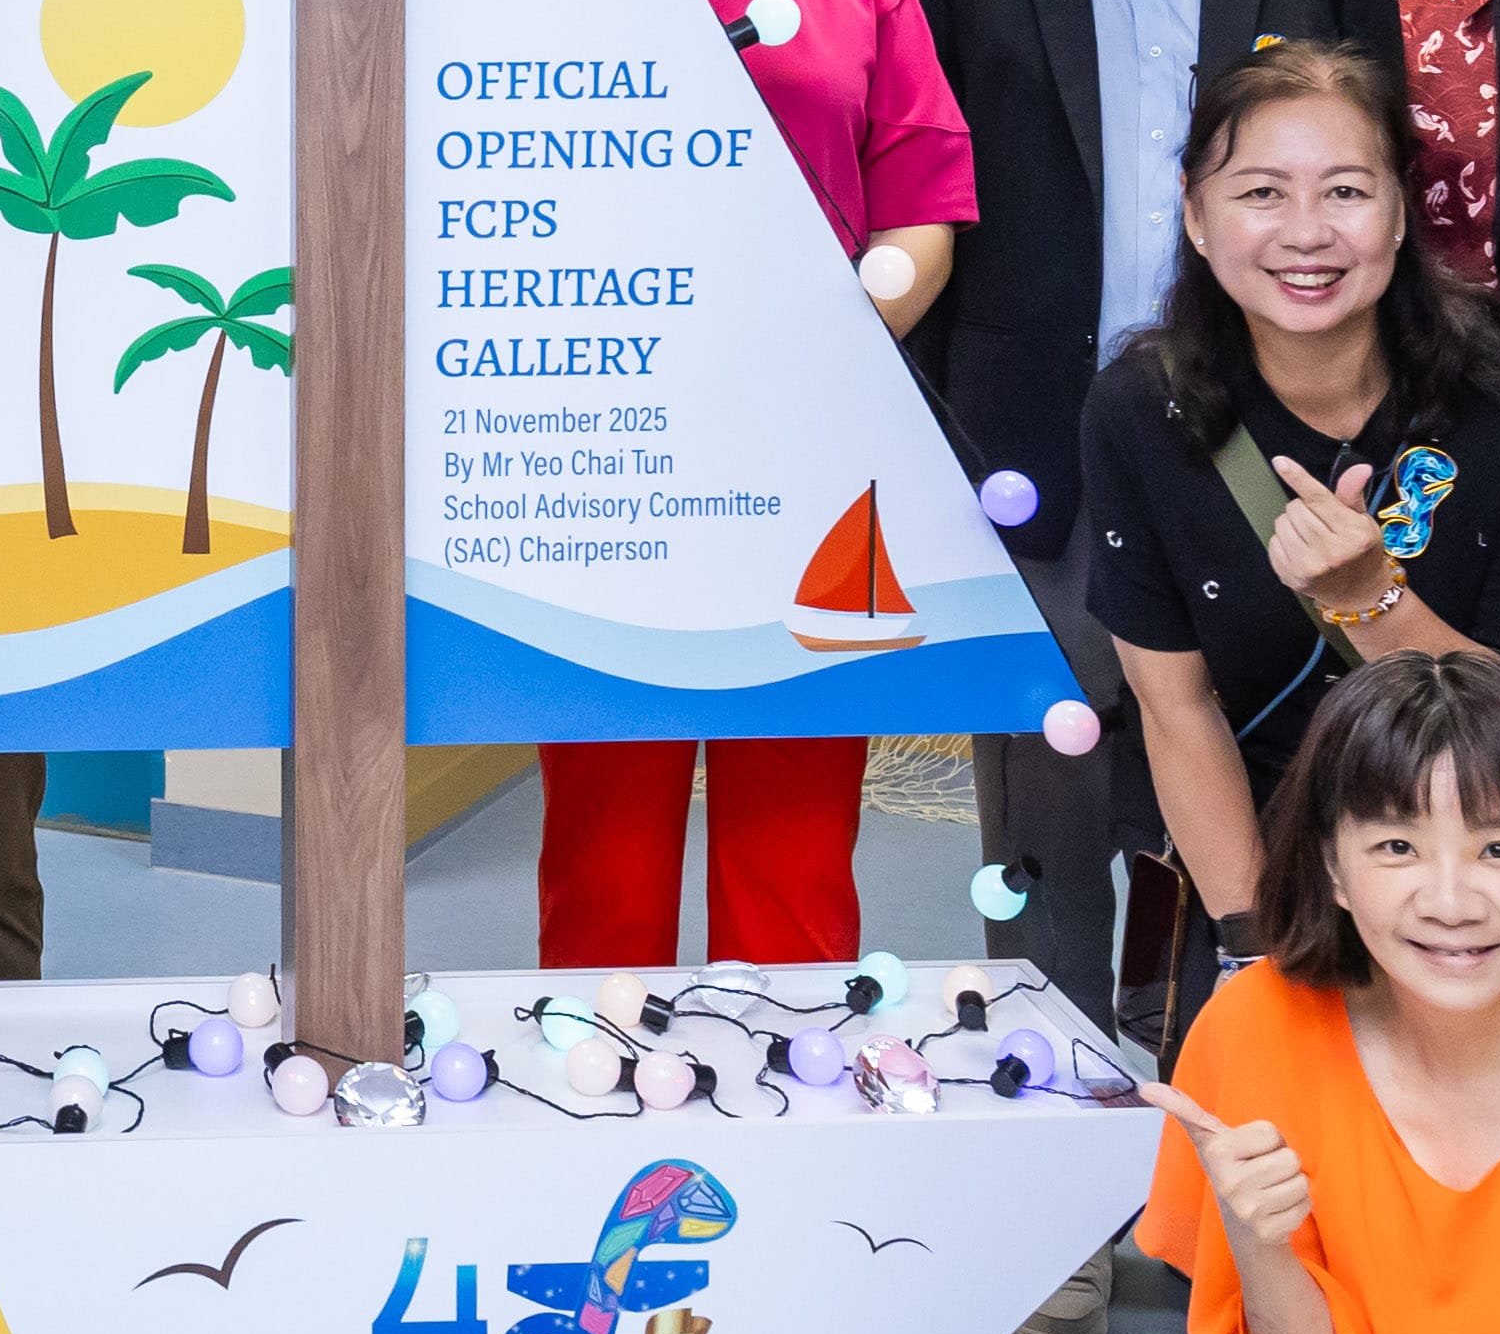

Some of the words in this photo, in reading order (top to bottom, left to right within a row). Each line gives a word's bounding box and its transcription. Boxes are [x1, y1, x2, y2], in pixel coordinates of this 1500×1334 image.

[437, 60, 668, 100] OFFICIAL
[437, 129, 674, 169] OPENING
[687, 128, 752, 167] OF
[438, 199, 557, 239] FCPS
[438, 266, 695, 308] HERITAGE
[436, 336, 661, 377] GALLERY
[444, 409, 467, 434] 21
[476, 406, 602, 434] November
[609, 406, 667, 432] 2025
[445, 453, 473, 484] By
[483, 451, 513, 477] Mr
[520, 451, 563, 477] Yeo
[571, 448, 624, 476] Chai
[631, 449, 674, 475] Tun
[444, 494, 527, 520] School
[535, 491, 641, 524] Advisory
[649, 490, 782, 517] Committee
[444, 536, 511, 568] (SAC)
[519, 534, 668, 567] Chairperson
